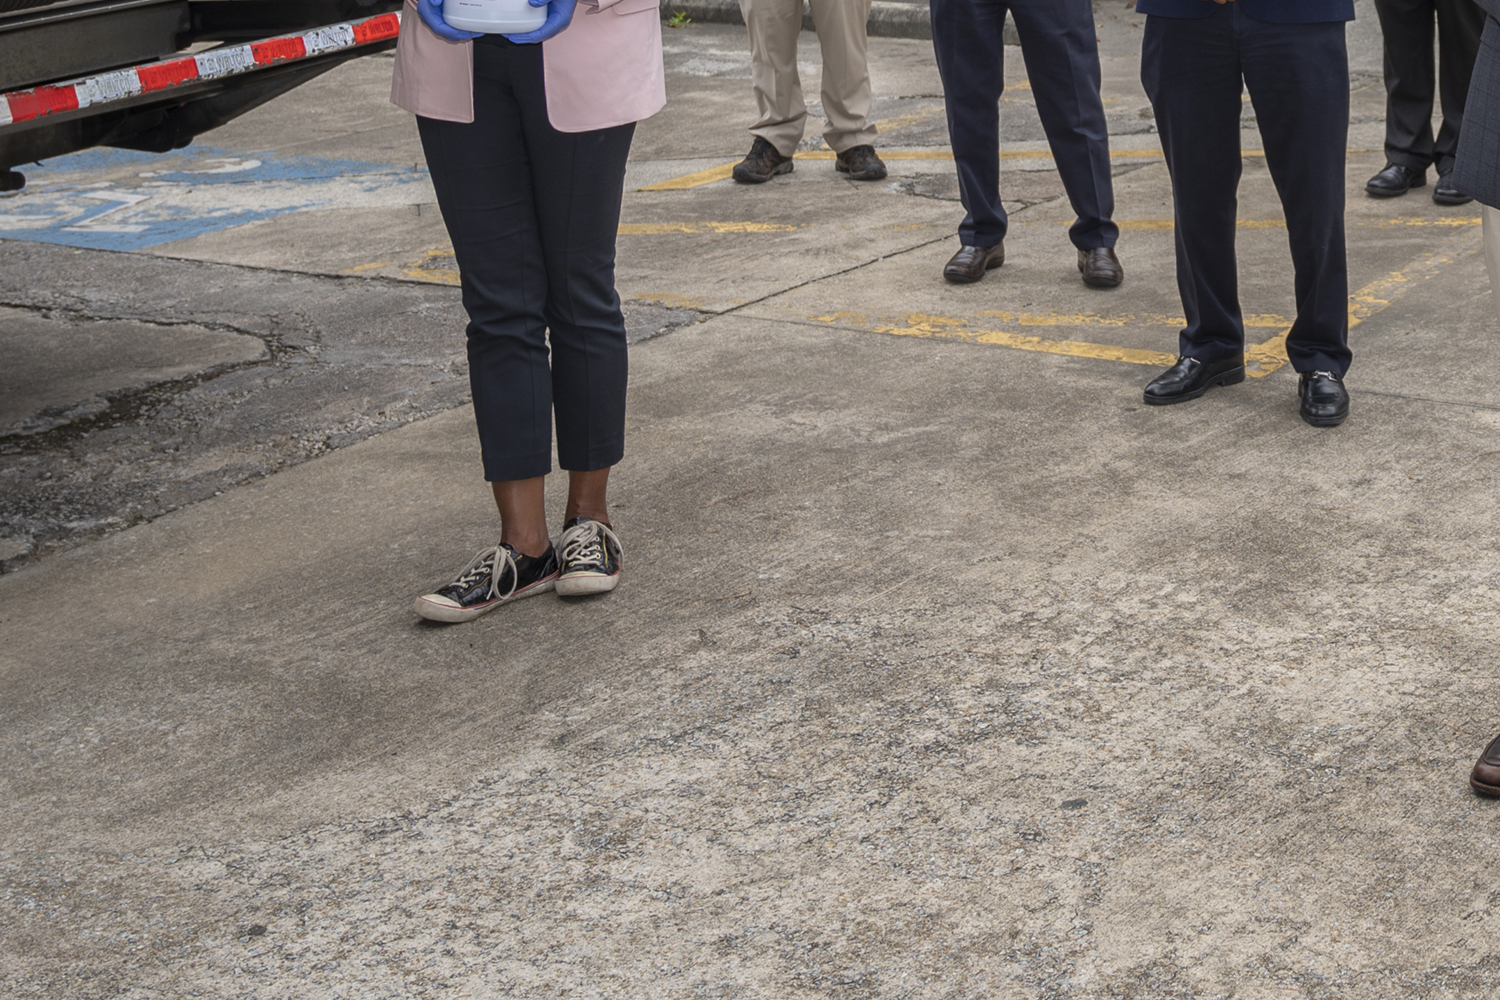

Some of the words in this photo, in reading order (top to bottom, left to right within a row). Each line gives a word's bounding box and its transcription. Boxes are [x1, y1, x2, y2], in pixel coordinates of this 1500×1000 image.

[369, 20, 394, 36] WALTCO
[320, 30, 347, 47] WALTCO
[216, 52, 246, 70] WALTCO
[100, 77, 131, 97] WALTCO
